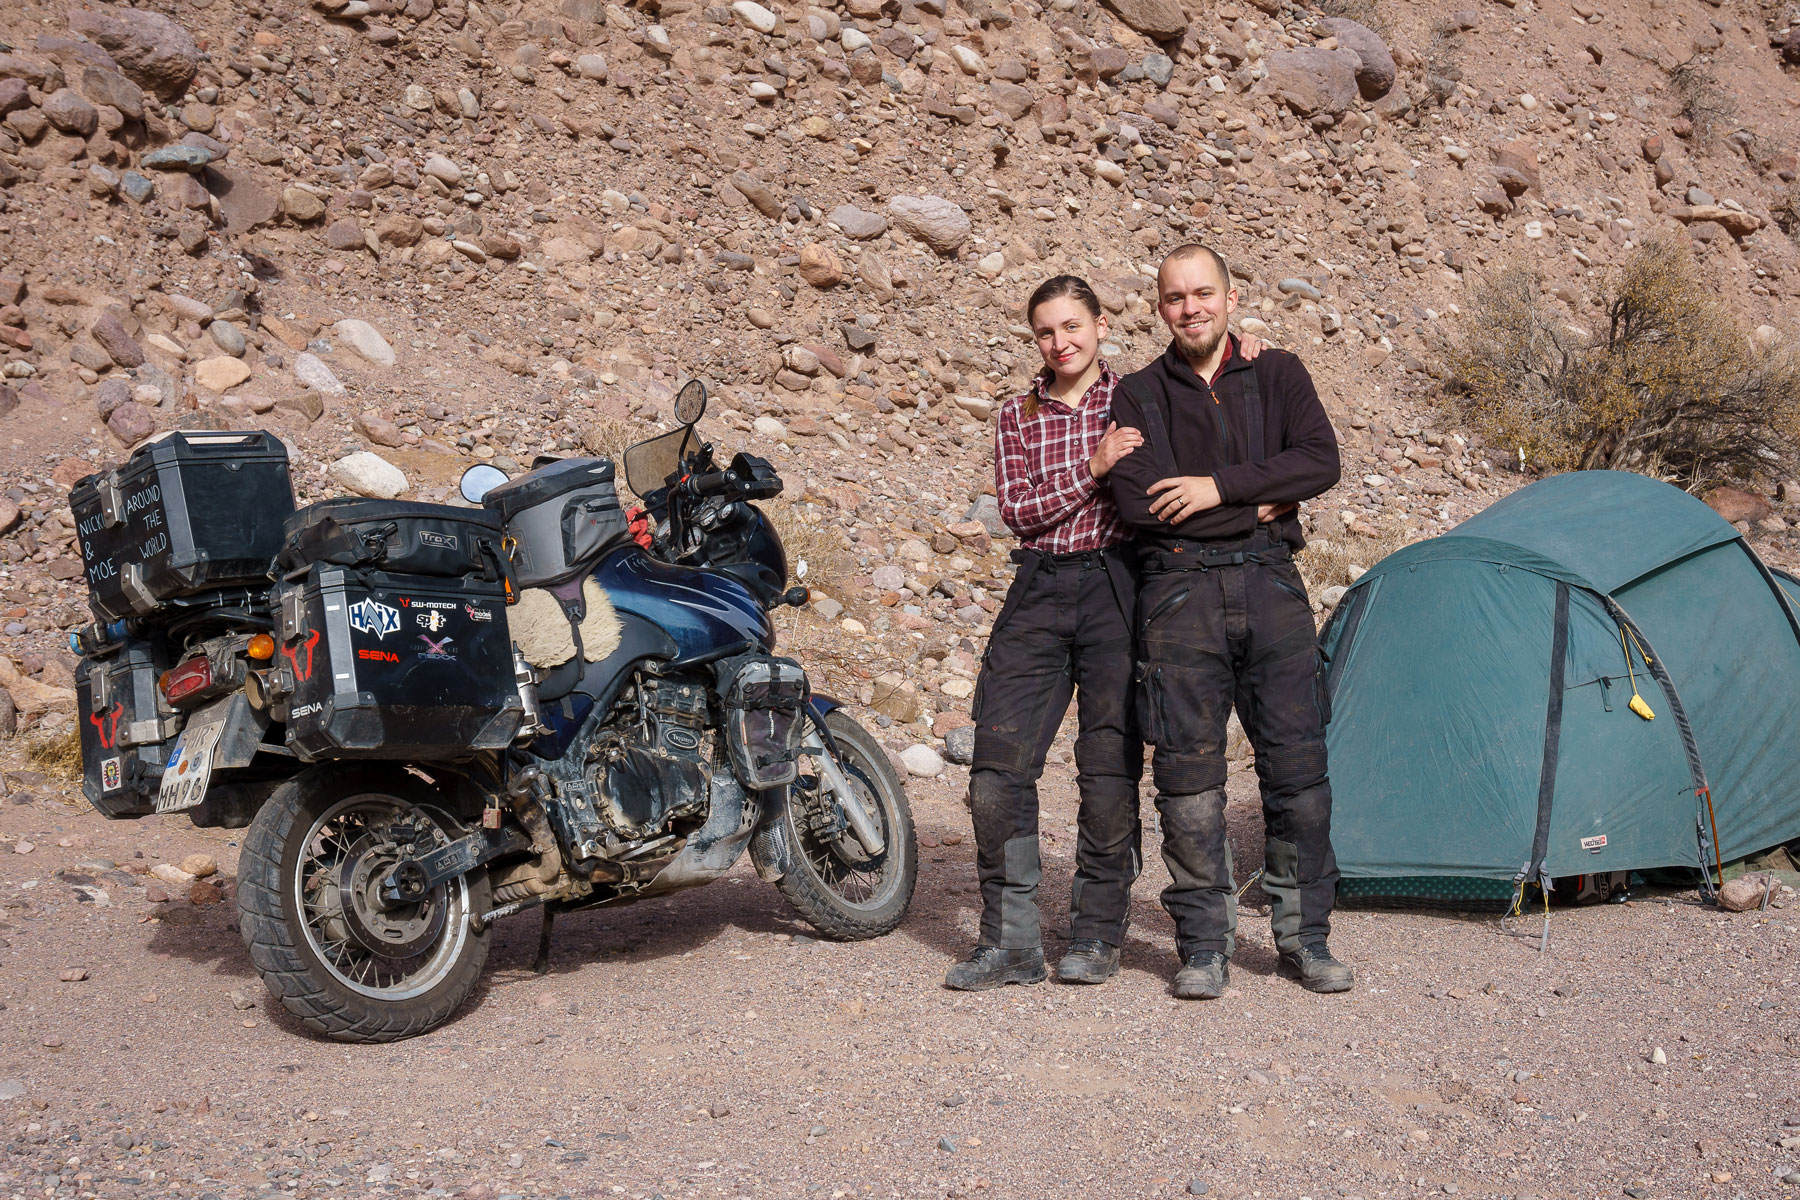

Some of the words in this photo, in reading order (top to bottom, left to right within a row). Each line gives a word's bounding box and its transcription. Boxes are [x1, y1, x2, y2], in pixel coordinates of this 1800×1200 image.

[126, 484, 161, 515] AROUND
[142, 509, 162, 531] THE
[85, 541, 94, 561] &
[139, 532, 167, 559] WORLD
[89, 557, 118, 584] MOE
[411, 601, 457, 609] SW-MOTECH
[358, 649, 400, 663] SENA
[291, 701, 324, 720] SENA
